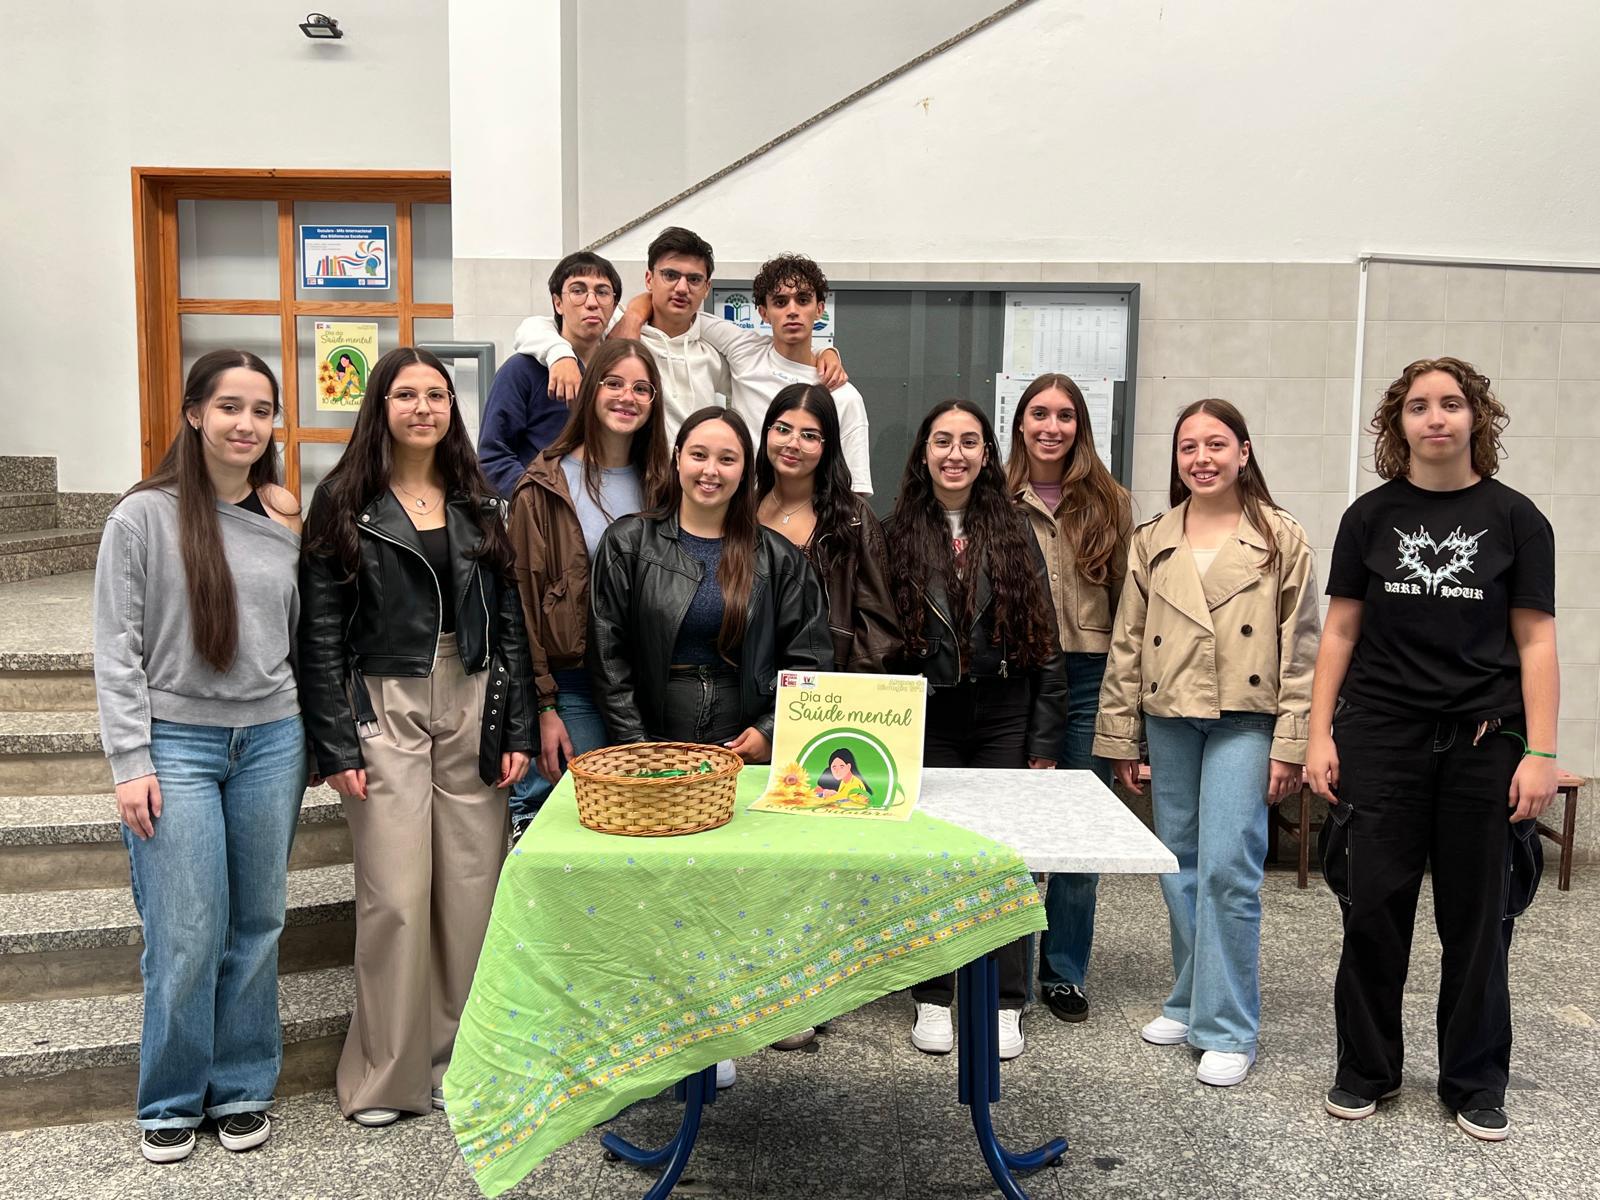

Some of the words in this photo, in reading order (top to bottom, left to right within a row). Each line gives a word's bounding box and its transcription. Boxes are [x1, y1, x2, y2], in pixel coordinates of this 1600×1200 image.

[320, 334, 344, 344] Saúde
[345, 336, 373, 344] mental
[1384, 581, 1421, 595] DARK
[1440, 585, 1484, 600] HOUR
[800, 691, 821, 703] Dia
[824, 692, 842, 704] da
[789, 701, 845, 721] Saúde
[848, 708, 912, 726] mental
[811, 806, 895, 817] Outubro
